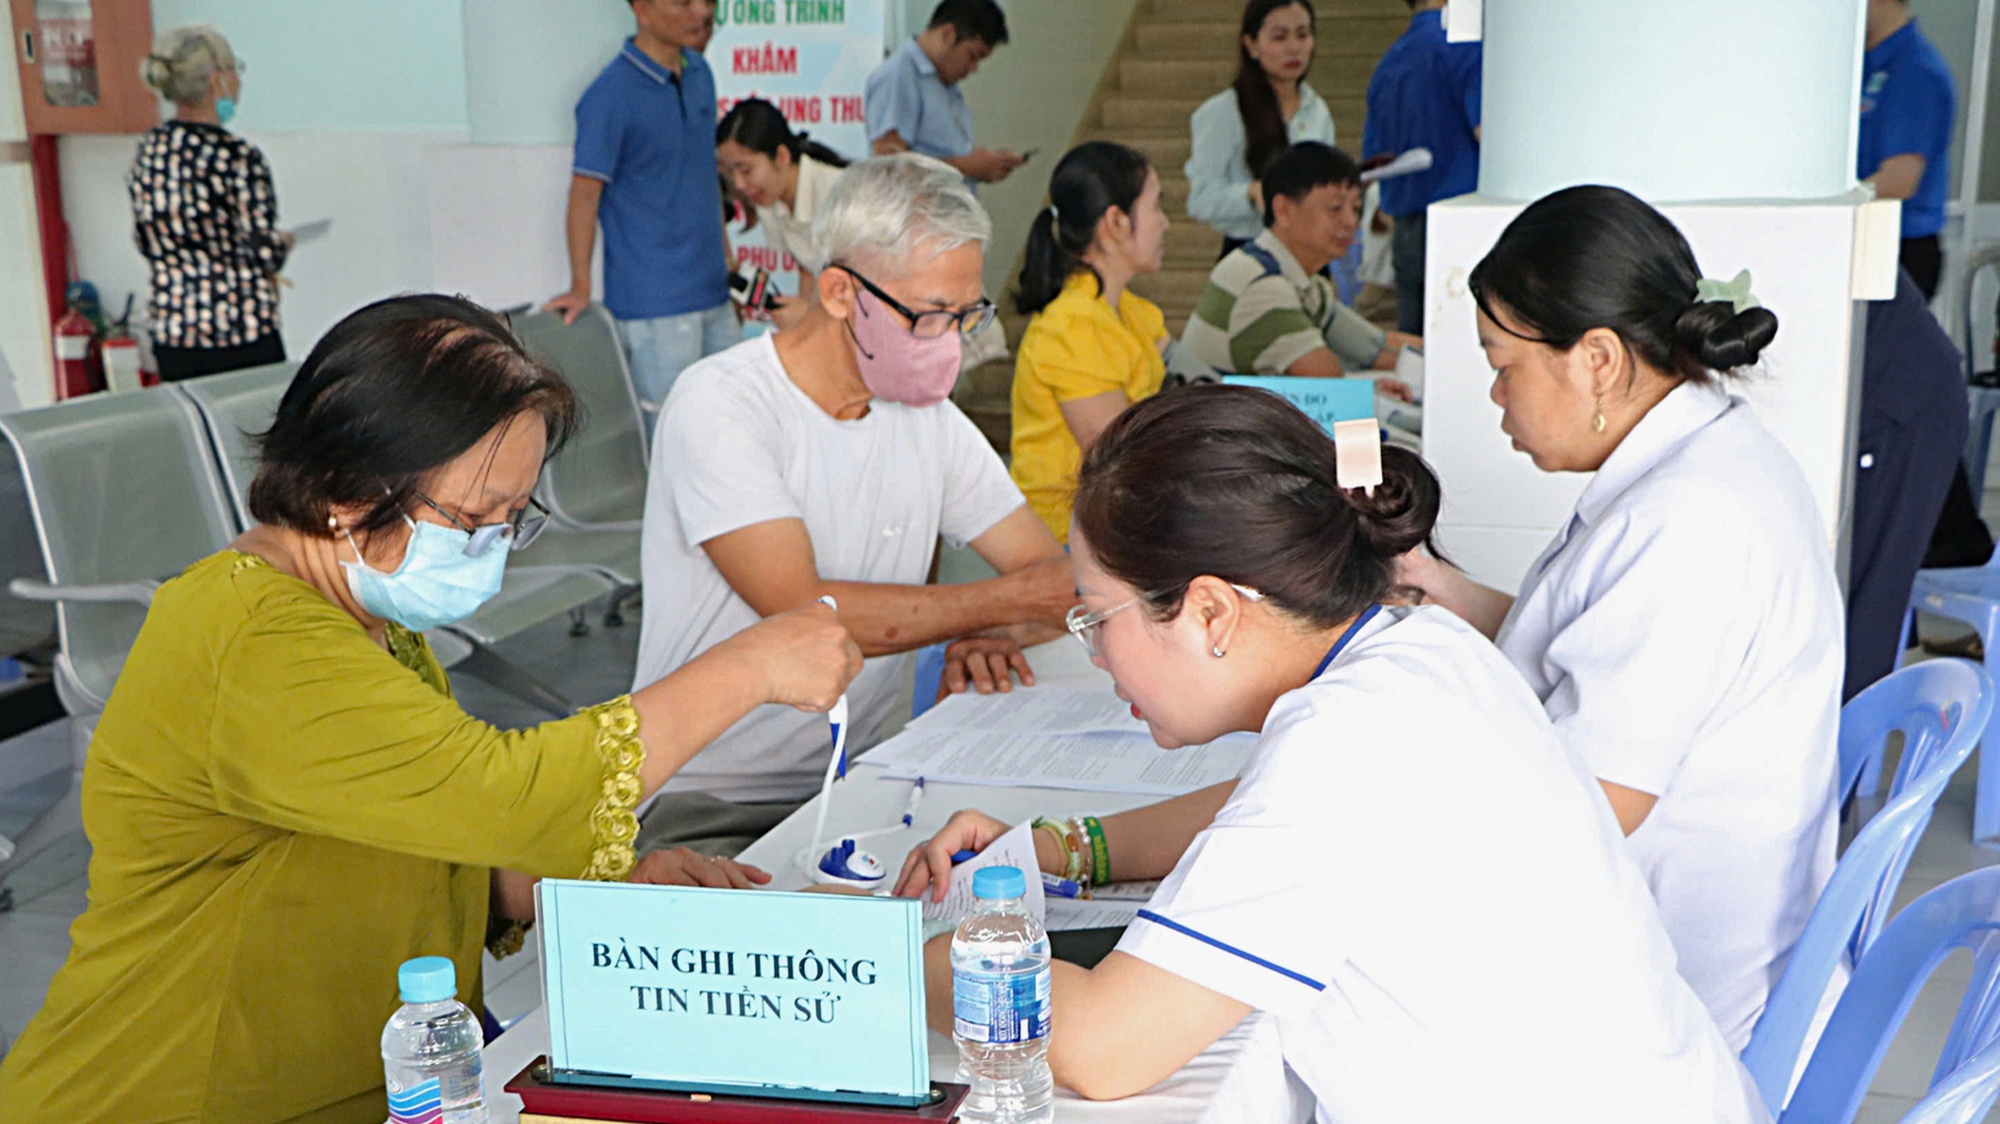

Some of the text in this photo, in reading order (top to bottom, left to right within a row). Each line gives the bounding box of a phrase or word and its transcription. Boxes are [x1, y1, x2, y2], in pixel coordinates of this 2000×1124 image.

[732, 41, 798, 74] KHÁM
[591, 937, 877, 985] BÀN GHI THÔNG
[629, 985, 842, 1024] TIN TIỀN SỬ
